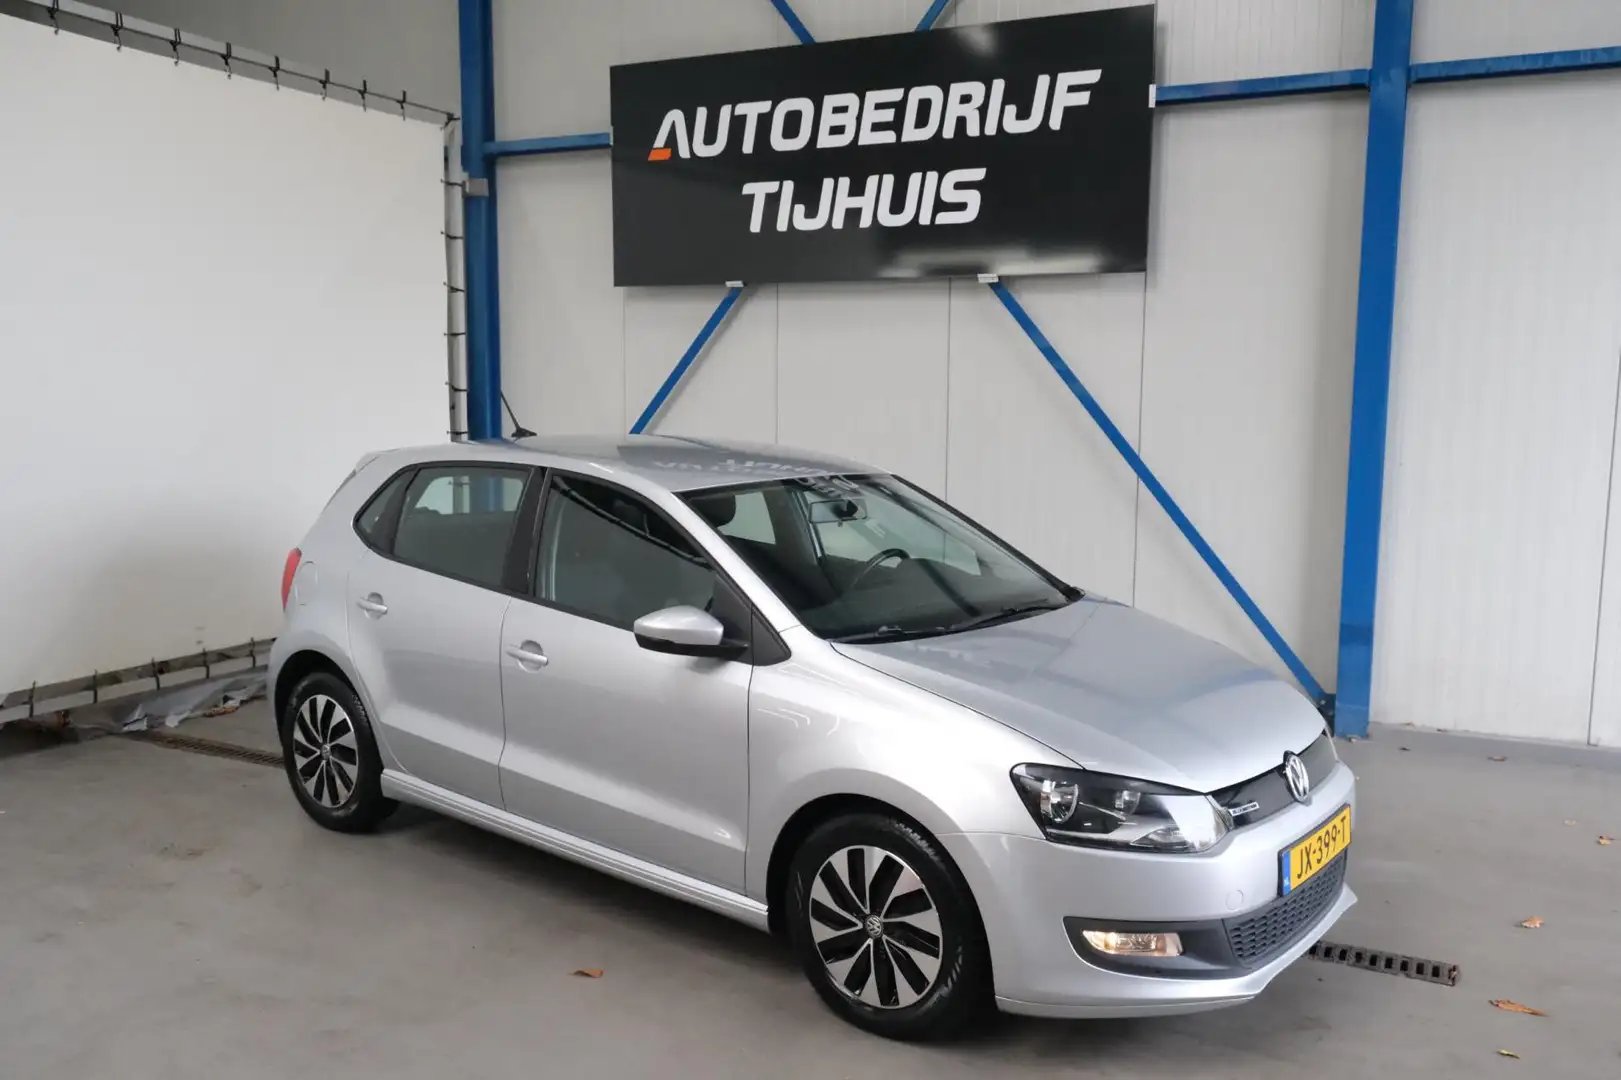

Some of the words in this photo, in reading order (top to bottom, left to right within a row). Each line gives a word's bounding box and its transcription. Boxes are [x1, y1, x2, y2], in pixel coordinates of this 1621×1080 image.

[648, 69, 1102, 161] AUTOBEDRIJF
[742, 168, 987, 233] TIJHUIS
[1297, 815, 1347, 879] JX-399-T
